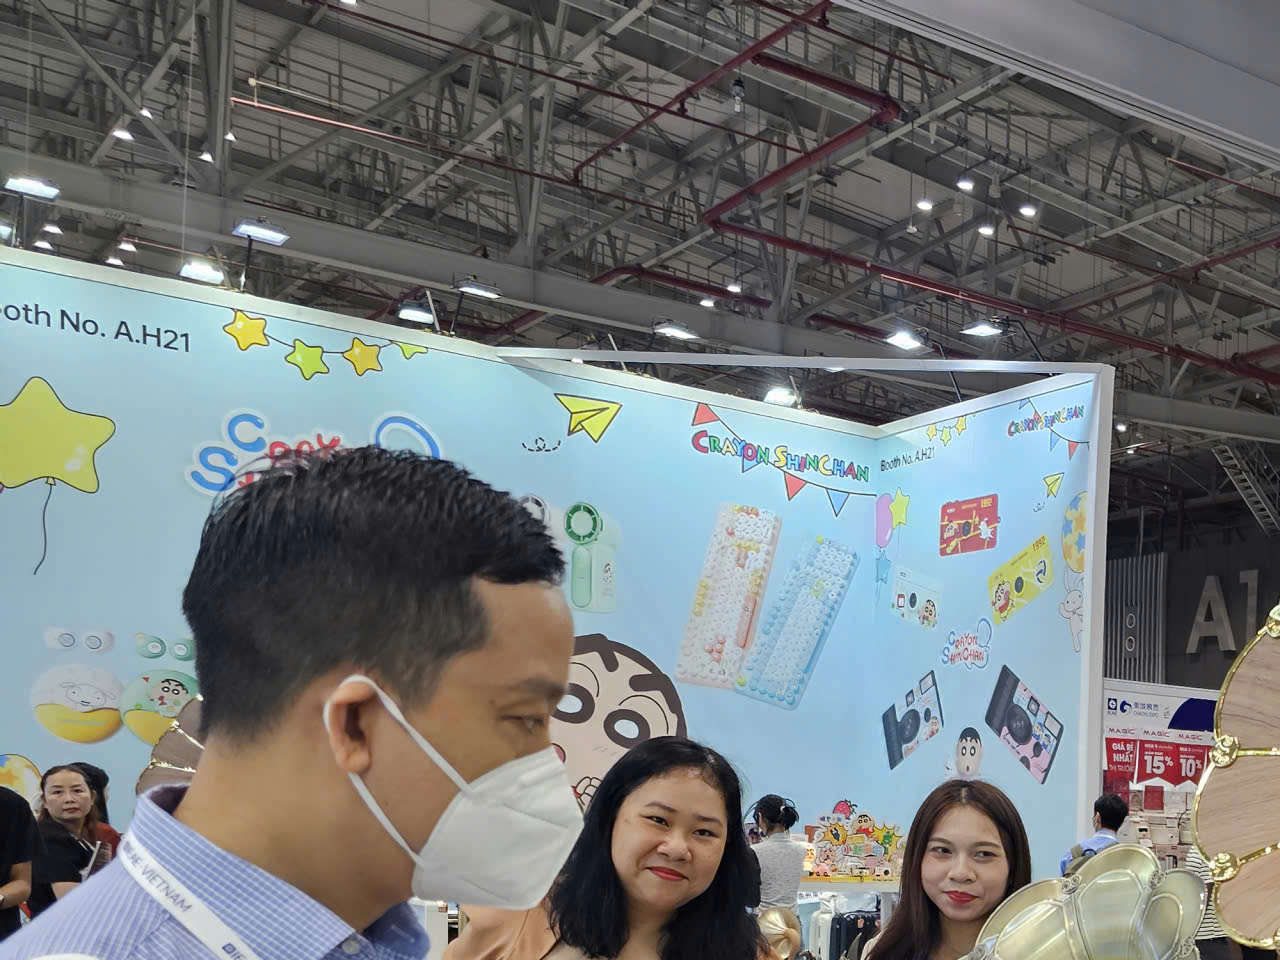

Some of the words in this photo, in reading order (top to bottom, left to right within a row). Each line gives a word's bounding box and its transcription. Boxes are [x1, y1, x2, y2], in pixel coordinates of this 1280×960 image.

[0, 303, 51, 328] oth
[60, 308, 106, 338] No.
[114, 320, 190, 353] A.H21
[691, 429, 770, 466] CRAYON
[773, 445, 870, 483] SHINCHAN
[880, 458, 901, 473] Booth
[901, 453, 913, 466] No.
[914, 447, 936, 464] A.H21
[1144, 756, 1174, 775] 15%
